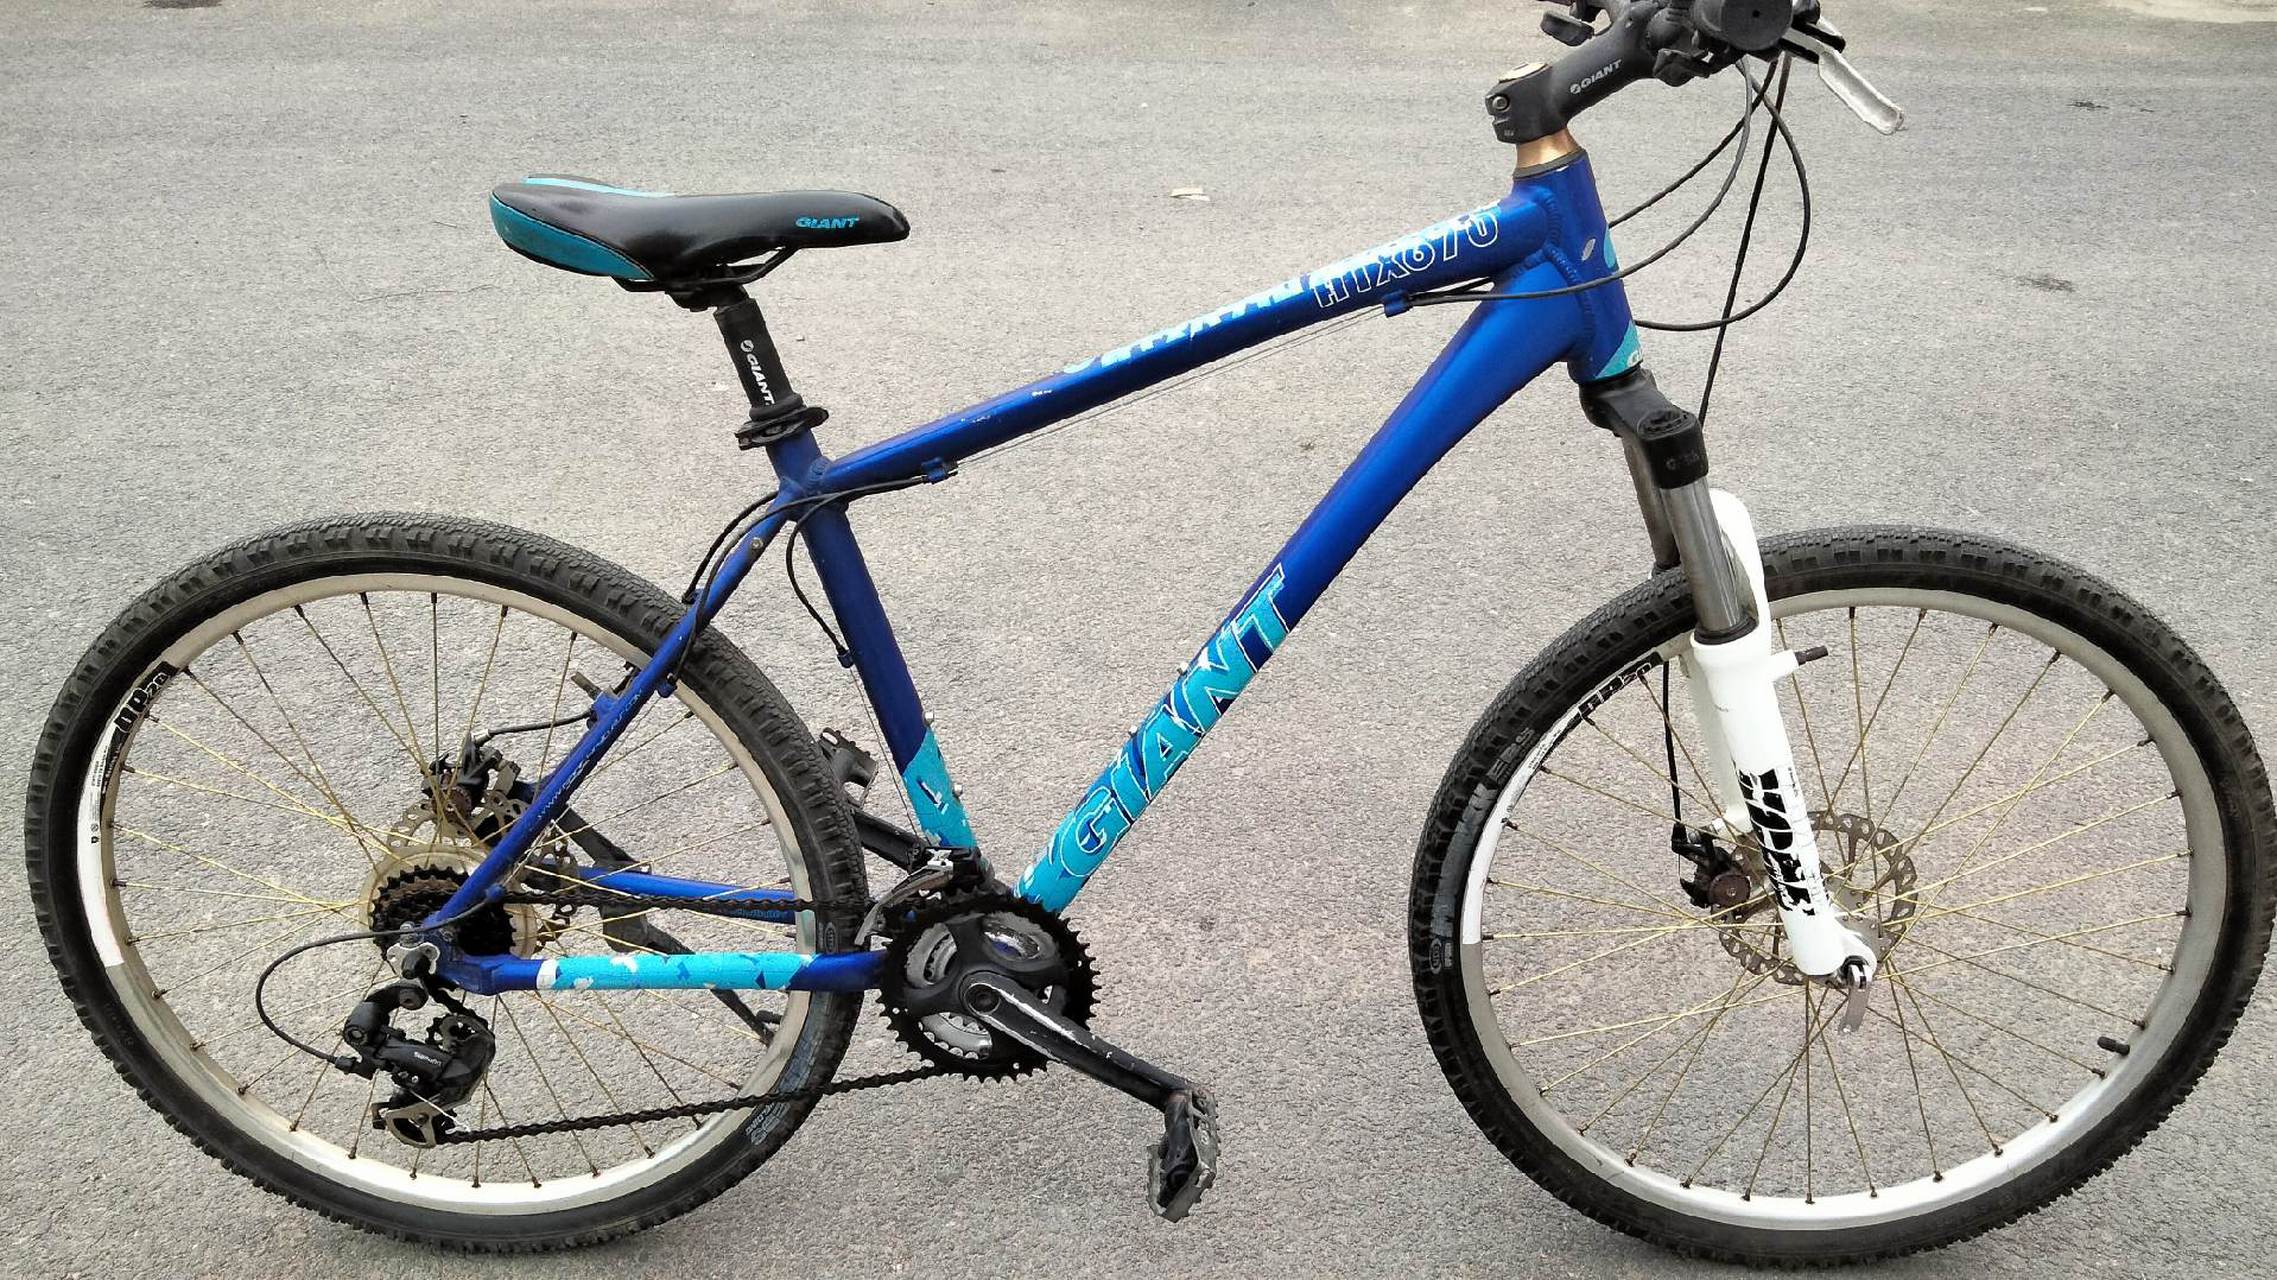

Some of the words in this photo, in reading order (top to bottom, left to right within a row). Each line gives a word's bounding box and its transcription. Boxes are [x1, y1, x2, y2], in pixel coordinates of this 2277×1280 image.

[1580, 58, 1623, 90] GIANT
[795, 216, 860, 229] GIANT
[747, 353, 776, 405] GIANT
[1060, 562, 1290, 878] GIANT
